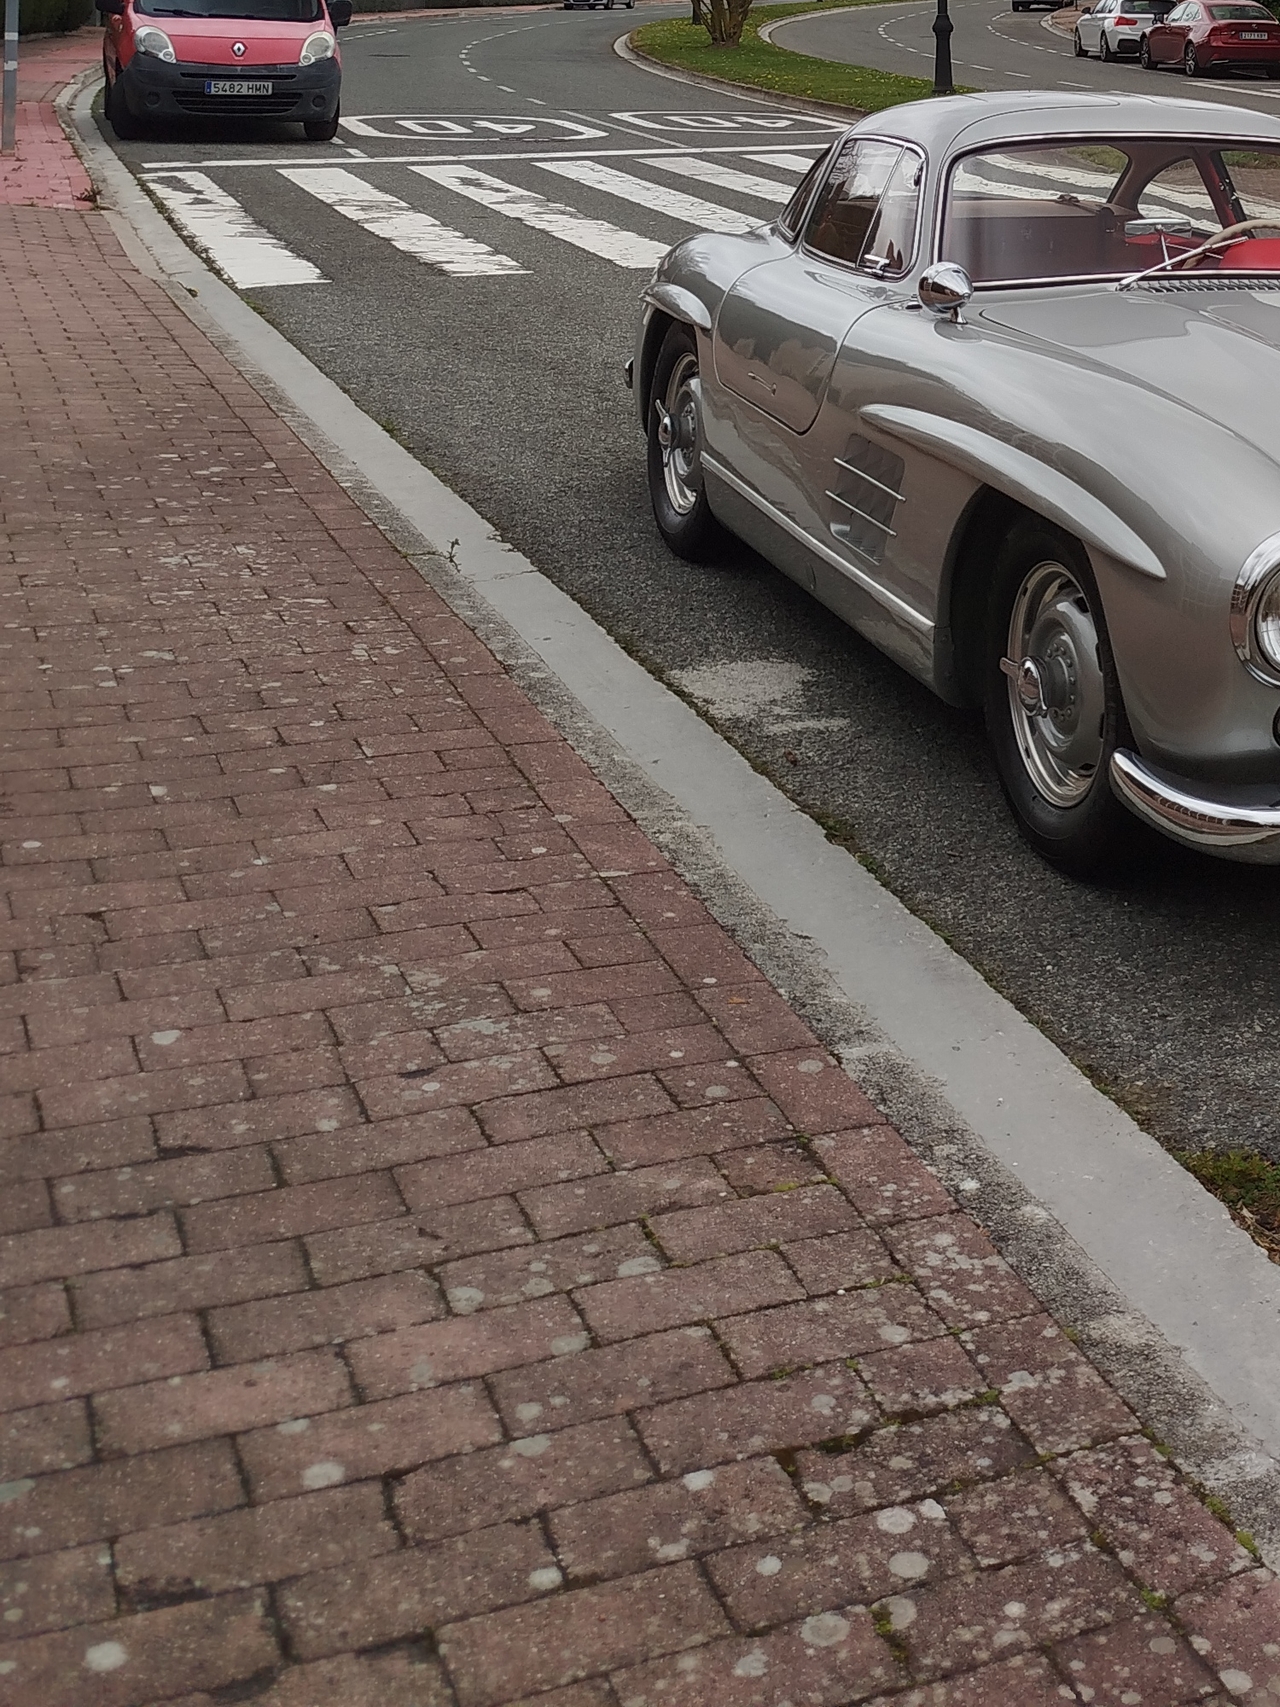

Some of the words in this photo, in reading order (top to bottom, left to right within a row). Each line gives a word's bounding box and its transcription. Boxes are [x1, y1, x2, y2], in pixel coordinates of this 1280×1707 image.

[213, 83, 244, 94] 5482
[247, 83, 270, 94] HMN
[395, 120, 537, 134] 40
[663, 116, 796, 128] 40
